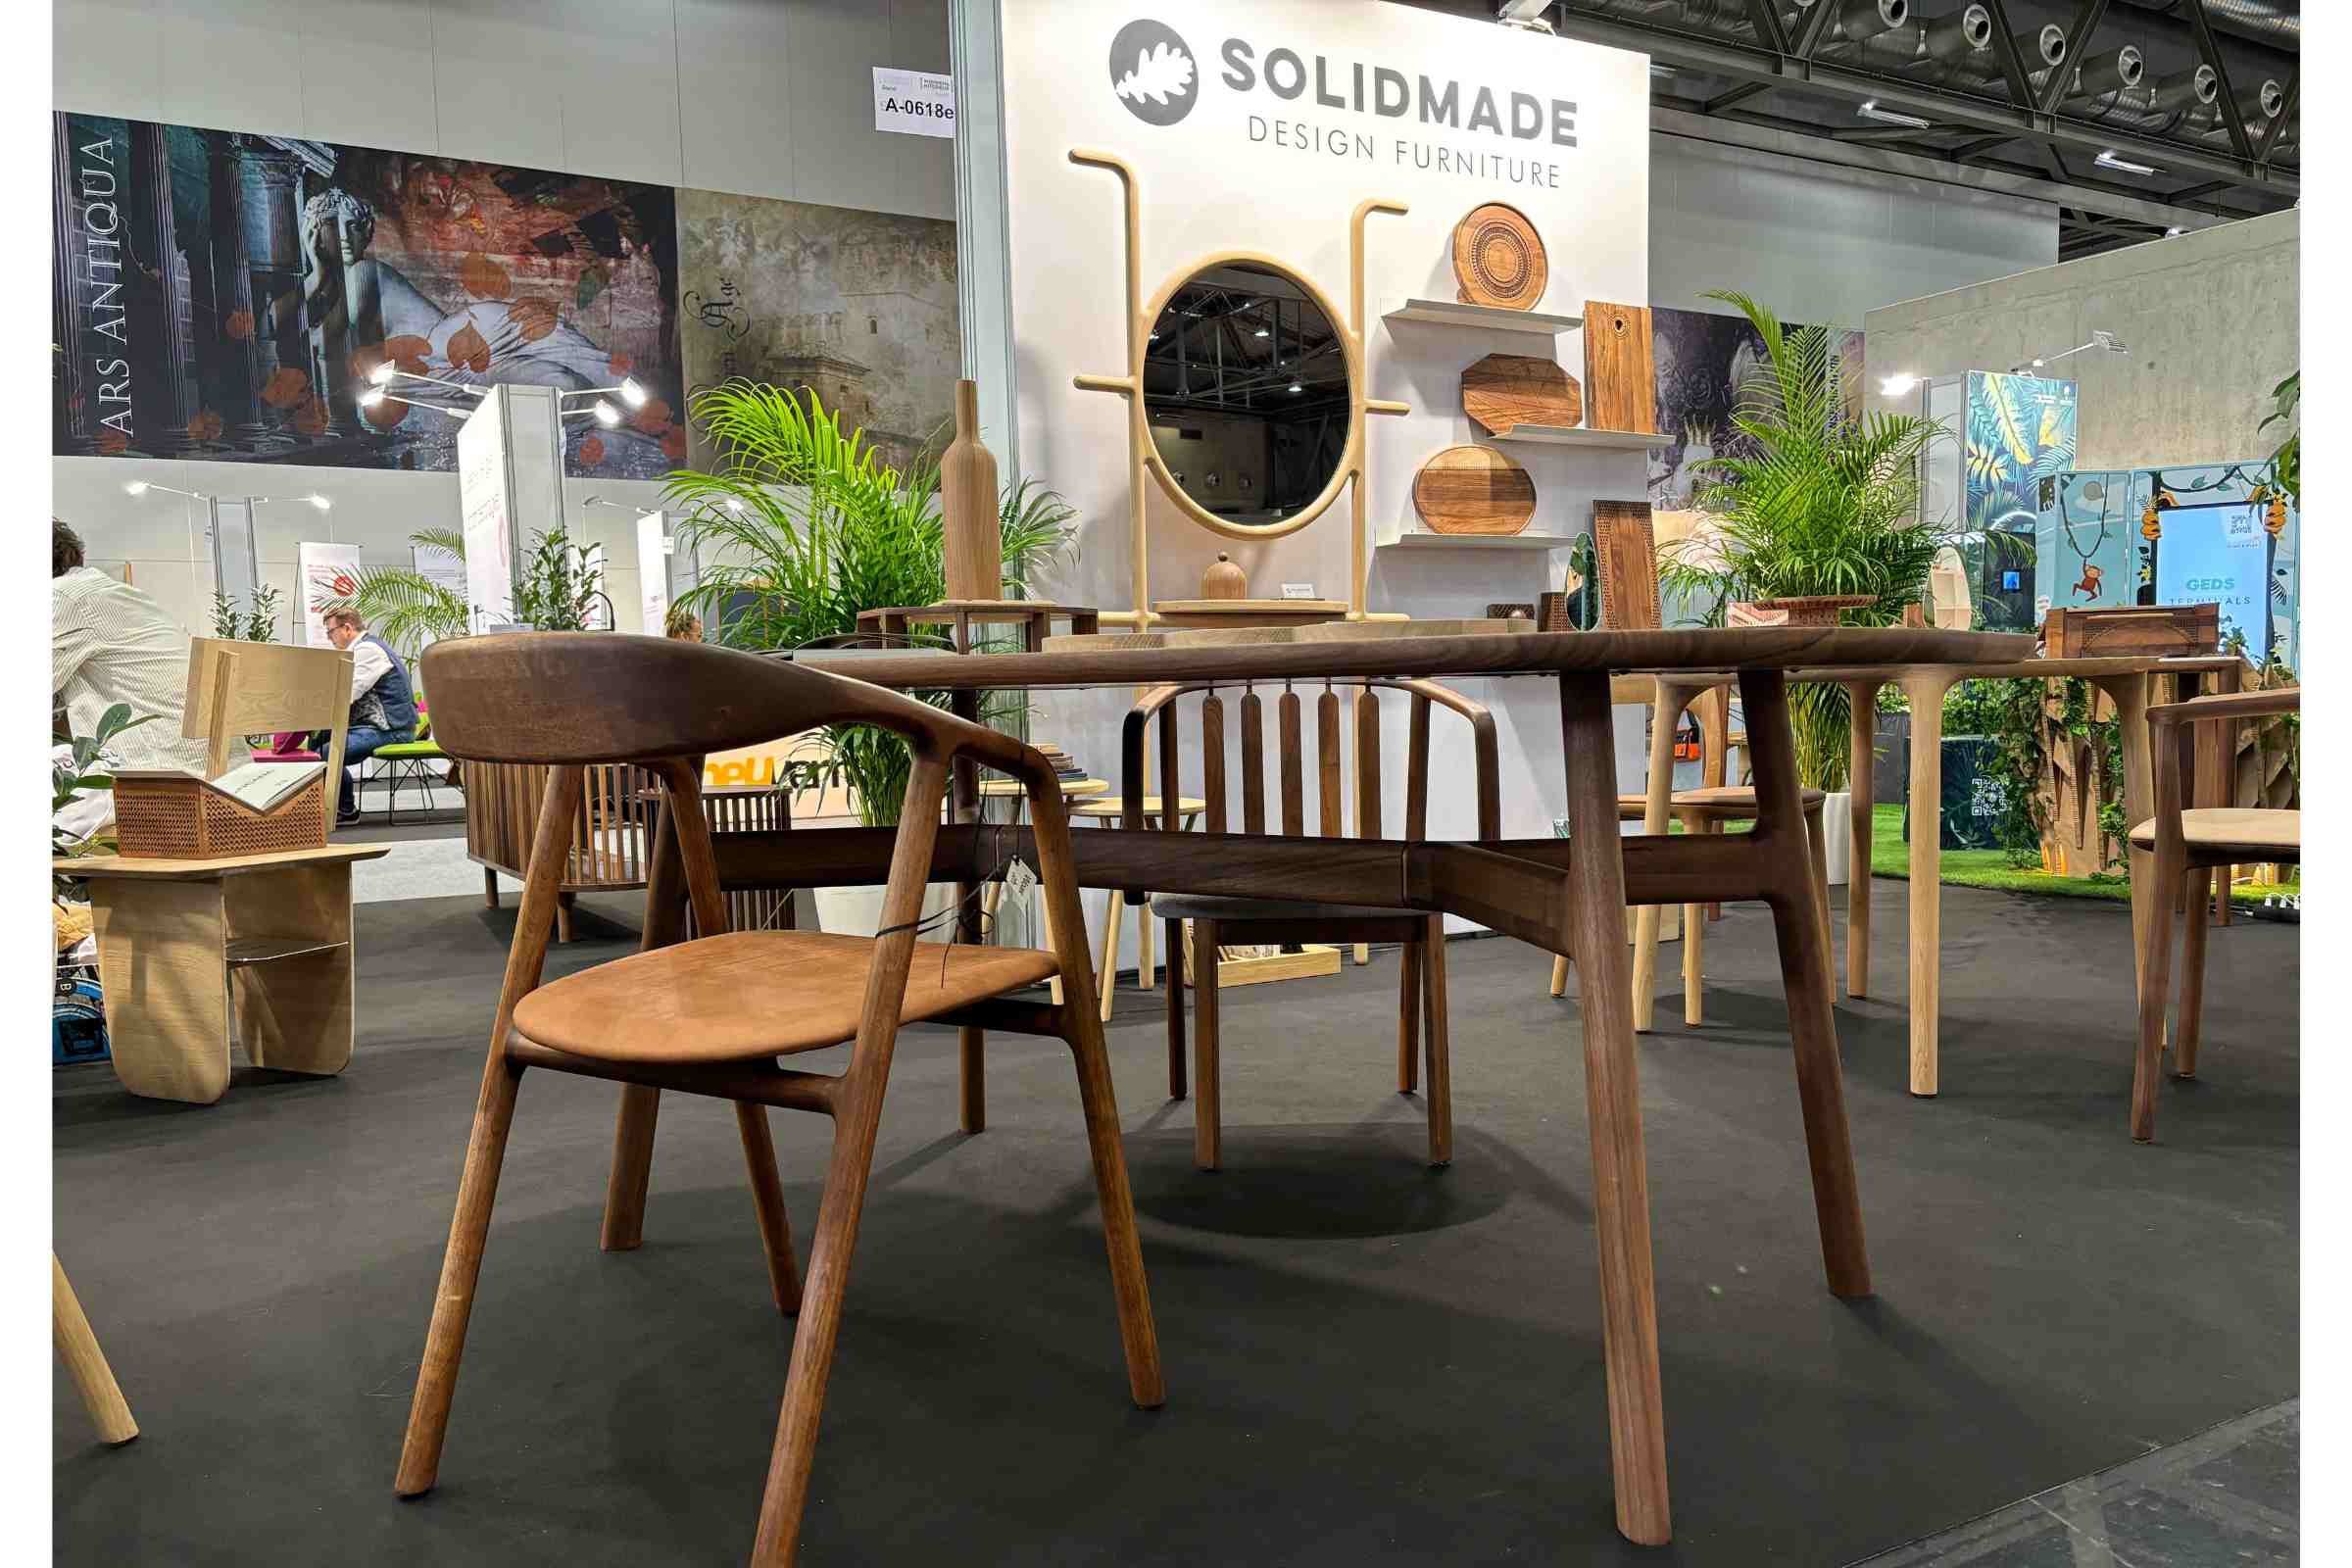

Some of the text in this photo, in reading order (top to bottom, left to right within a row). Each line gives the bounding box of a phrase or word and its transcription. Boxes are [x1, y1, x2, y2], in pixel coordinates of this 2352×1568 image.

[886, 97, 954, 119] A-0618e
[1221, 37, 1578, 147] SOLIDMADE
[1249, 116, 1560, 188] DESIGN FURNITURE
[80, 133, 133, 437] ARS ANTIQUA
[2186, 578, 2234, 590] GEDS
